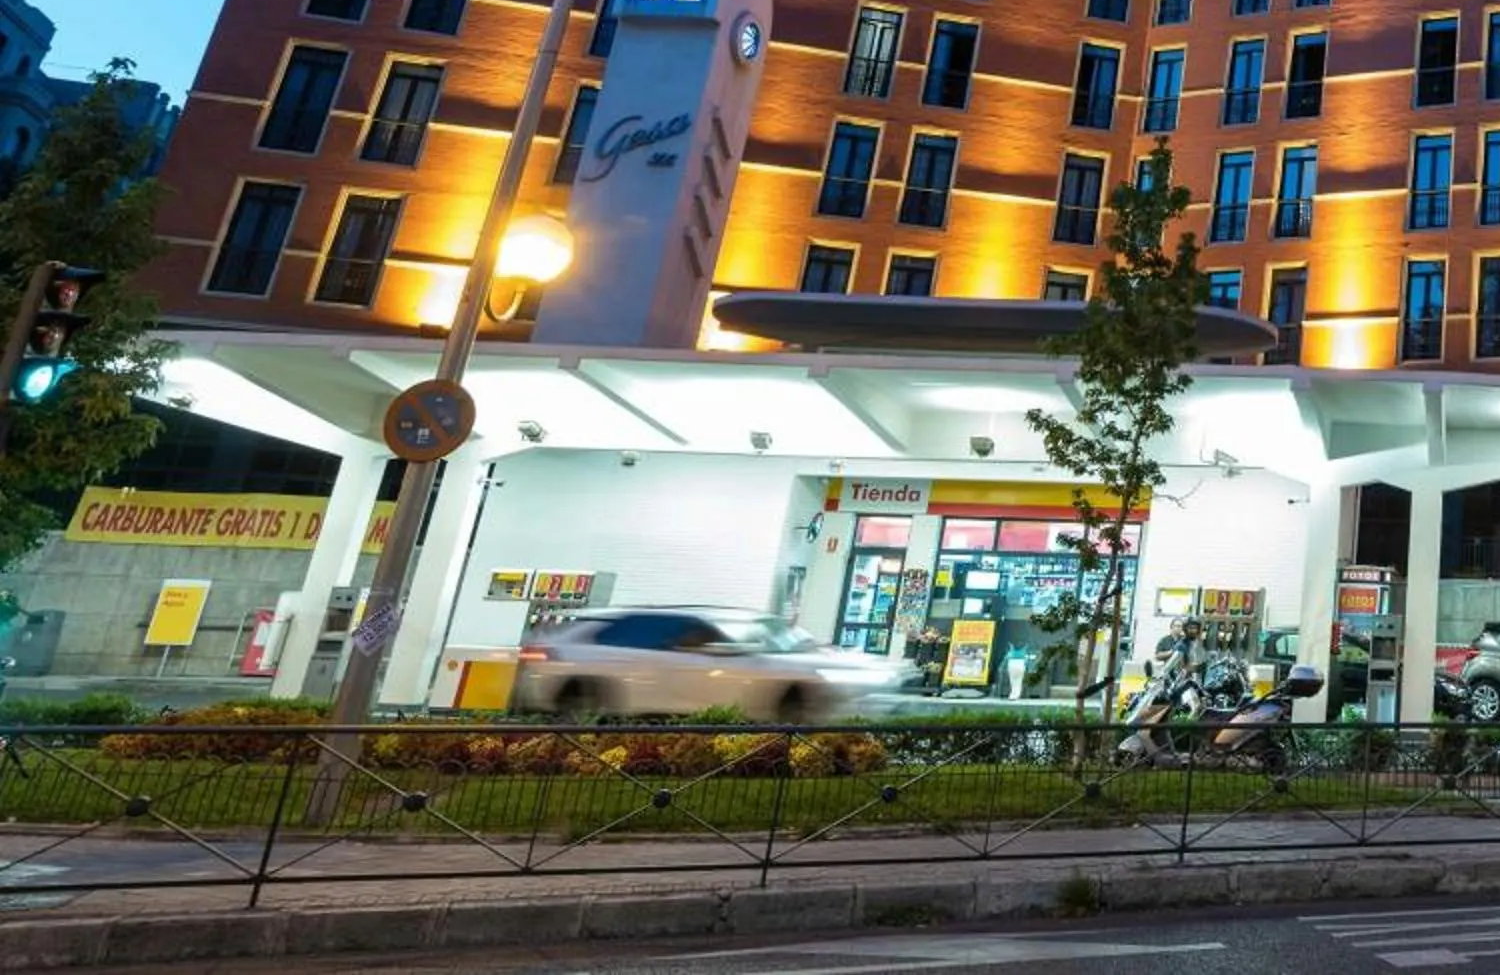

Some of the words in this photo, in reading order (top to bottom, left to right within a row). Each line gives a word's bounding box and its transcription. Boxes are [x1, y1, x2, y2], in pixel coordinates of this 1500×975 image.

[851, 483, 921, 502] Tienda
[81, 502, 216, 536] CARBURANTE
[215, 507, 288, 538] GRATIS
